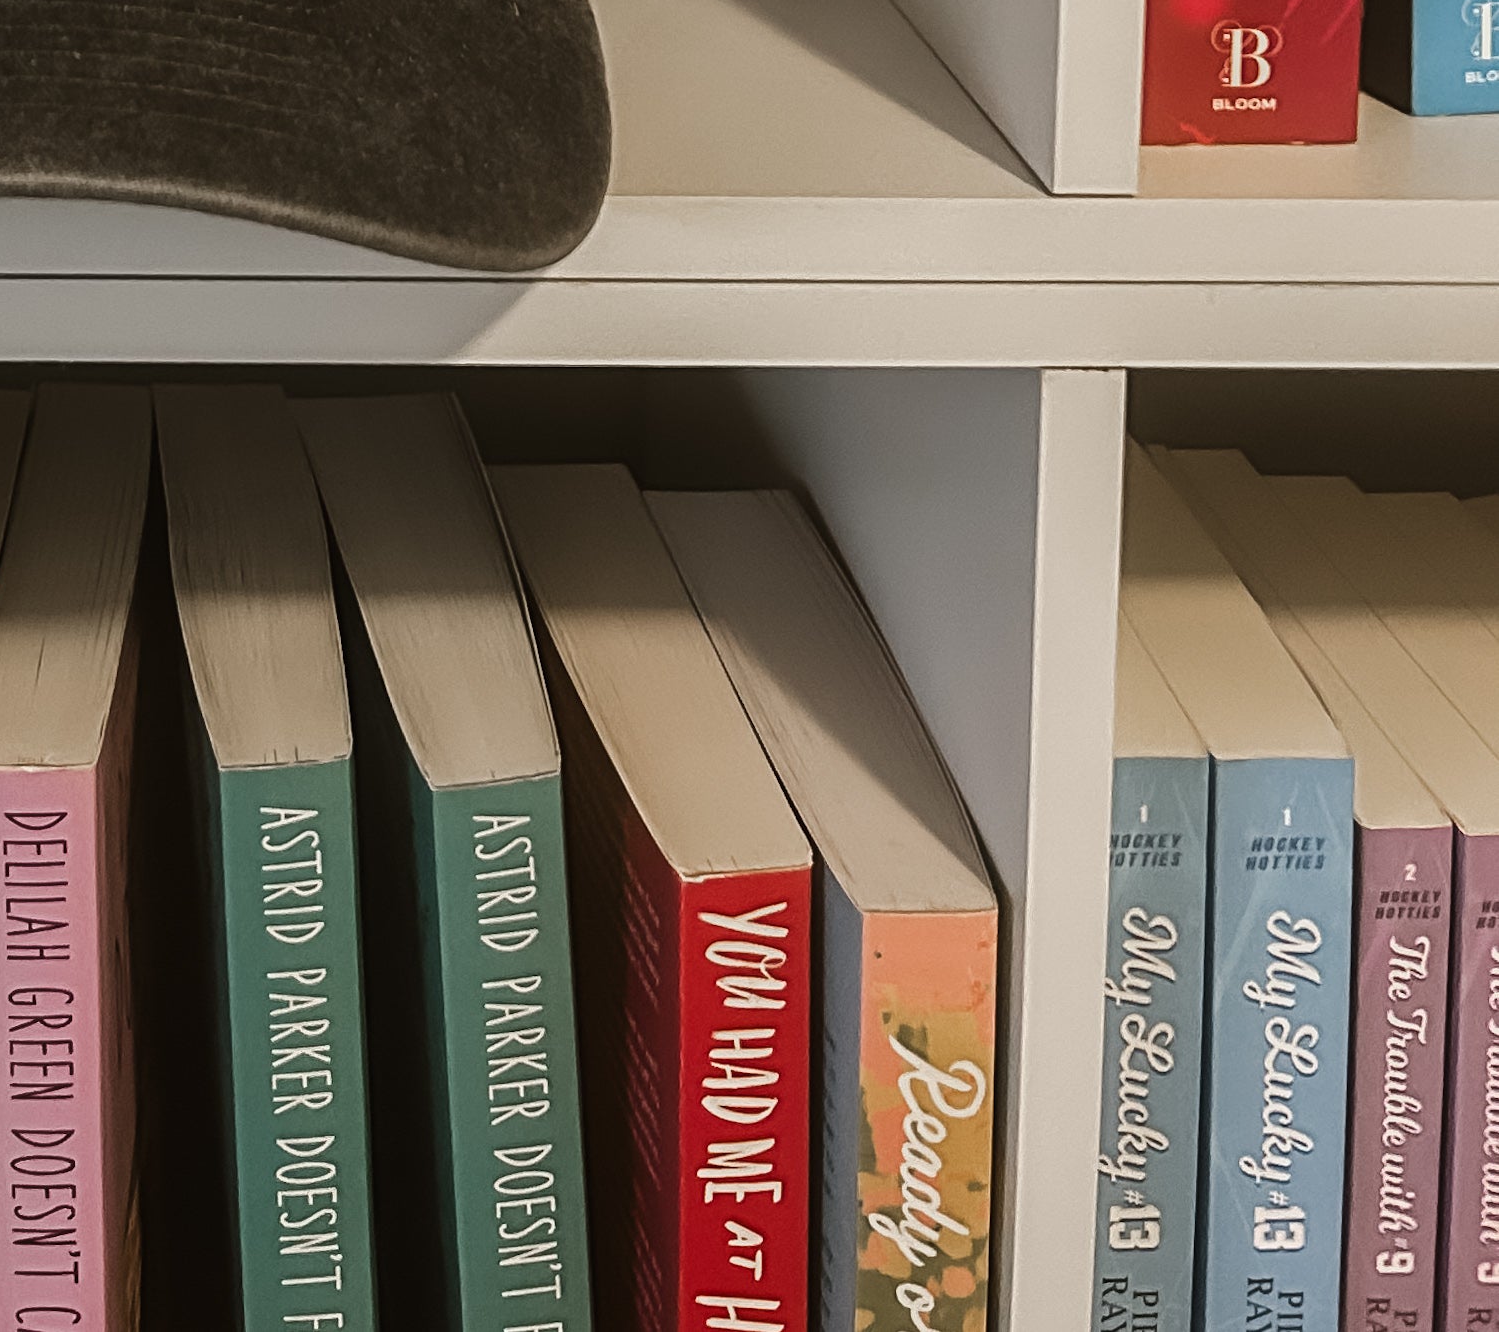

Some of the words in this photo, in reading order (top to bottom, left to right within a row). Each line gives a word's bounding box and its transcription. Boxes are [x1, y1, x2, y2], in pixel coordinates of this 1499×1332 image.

[1213, 98, 1277, 111] BLOOM
[3, 811, 71, 961] DELILAH
[260, 806, 325, 944] ASTRID
[472, 815, 539, 953] ASTRID
[1245, 853, 1326, 871] HOTTIES
[1251, 836, 1326, 852] HOCKEY
[1404, 863, 1417, 882] 2
[1243, 910, 1322, 1010] My
[1388, 935, 1430, 1002] The
[7, 987, 74, 1102] GREEN
[267, 968, 334, 1115] PARKER
[482, 975, 550, 1125] PARKER
[701, 1028, 779, 1124] HAD
[1099, 1013, 1175, 1184] Lucky
[1382, 1008, 1427, 1149] Trouble
[868, 1035, 987, 1267] Ready
[1240, 1015, 1318, 1186] Lucky
[11, 1129, 81, 1283] DOESN'T
[275, 1135, 343, 1291] DOESN'T
[493, 1144, 562, 1300] DOESN'T
[697, 1138, 783, 1204] ME
[1108, 1188, 1161, 1252] #13
[1253, 1190, 1307, 1253] #13
[1378, 1152, 1419, 1235] with
[724, 1220, 764, 1281] AT
